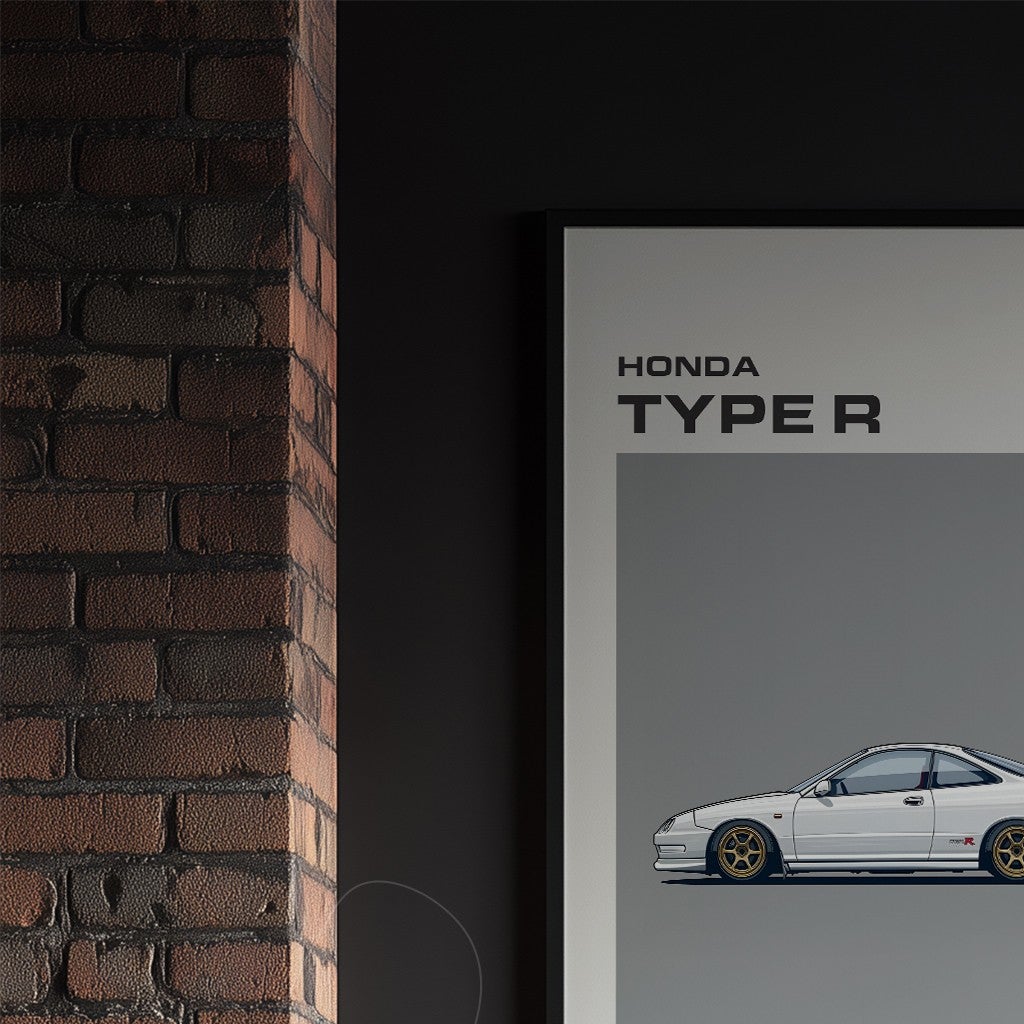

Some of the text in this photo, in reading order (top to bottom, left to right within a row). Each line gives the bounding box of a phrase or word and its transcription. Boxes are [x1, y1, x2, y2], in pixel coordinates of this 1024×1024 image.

[618, 355, 760, 377] HONDA
[617, 394, 881, 434] TYPE R
